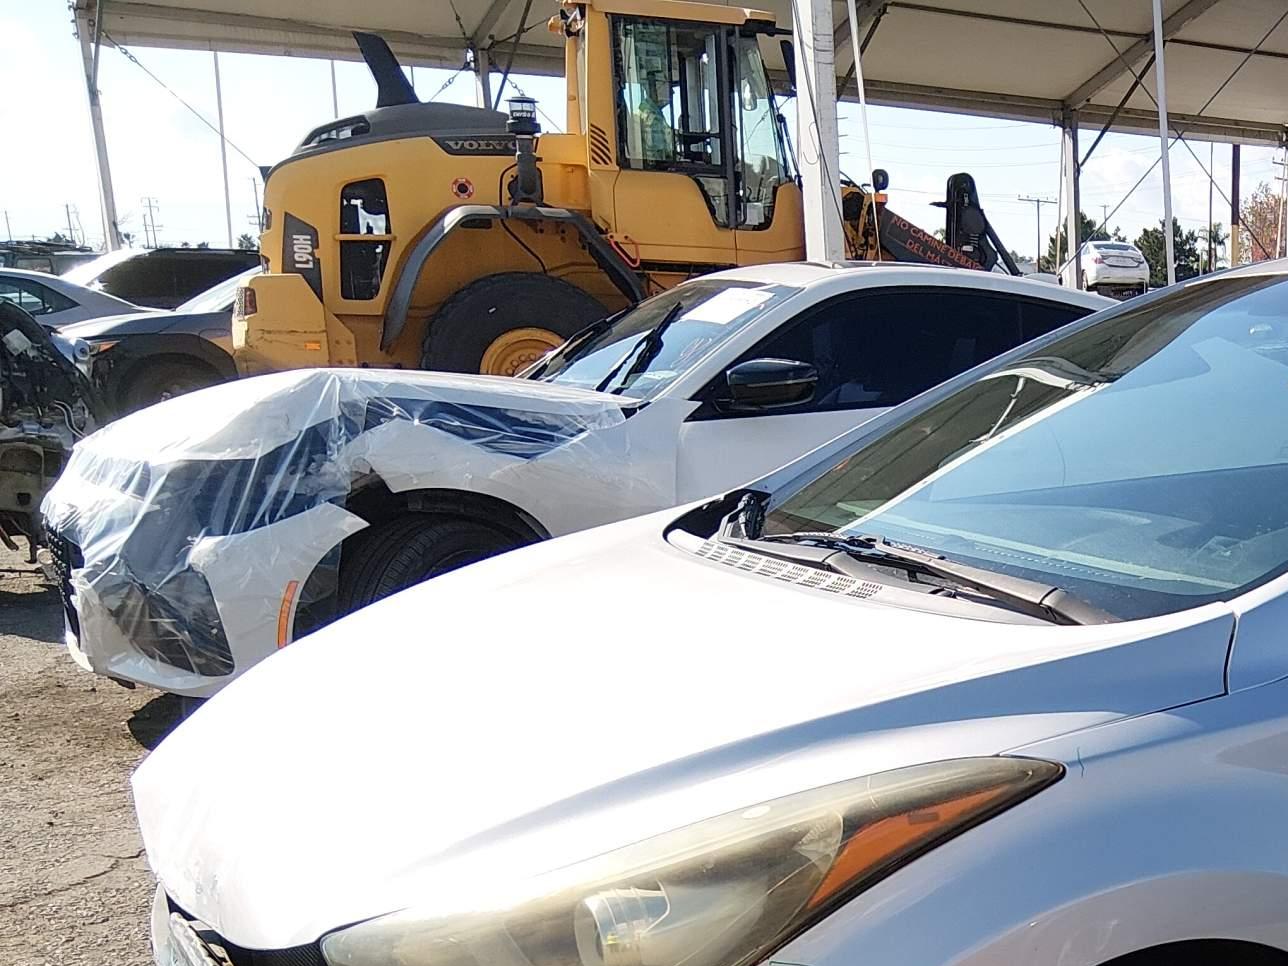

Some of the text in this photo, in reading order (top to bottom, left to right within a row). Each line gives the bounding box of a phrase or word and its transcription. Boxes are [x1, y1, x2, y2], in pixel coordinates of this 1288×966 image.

[445, 140, 517, 151] VOLVO
[891, 215, 909, 231] NO
[292, 234, 314, 269] L90H
[905, 239, 928, 258] DEL
